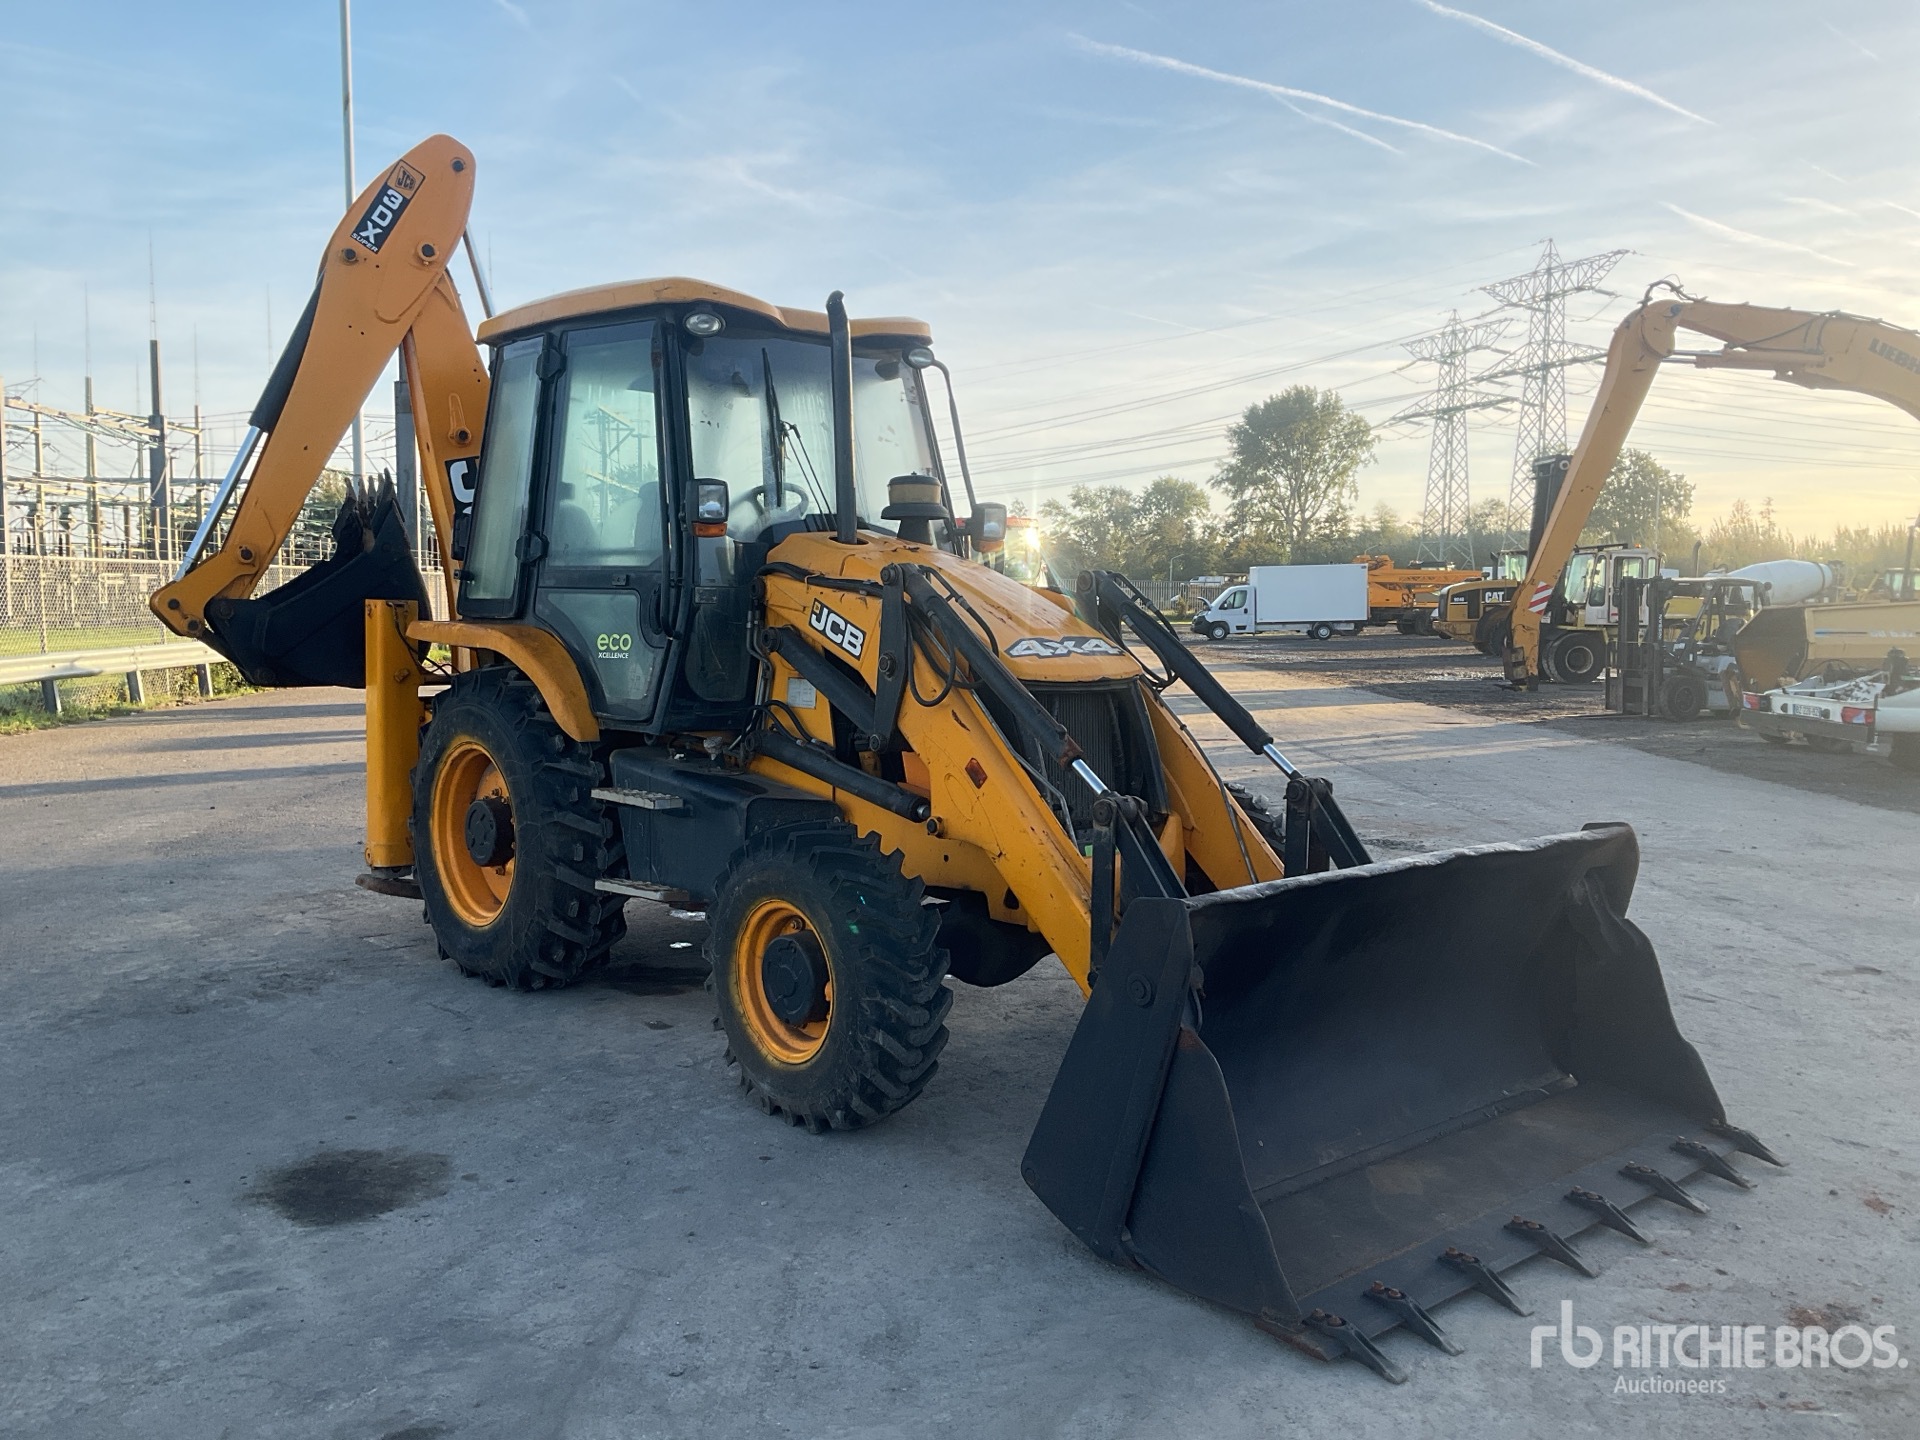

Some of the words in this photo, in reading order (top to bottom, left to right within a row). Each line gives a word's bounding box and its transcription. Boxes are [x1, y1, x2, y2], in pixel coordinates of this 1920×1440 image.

[359, 188, 404, 244] 3DX
[351, 232, 379, 252] SUPER
[1485, 592, 1504, 603] CAT
[810, 607, 864, 656] JCB
[597, 633, 632, 651] eco
